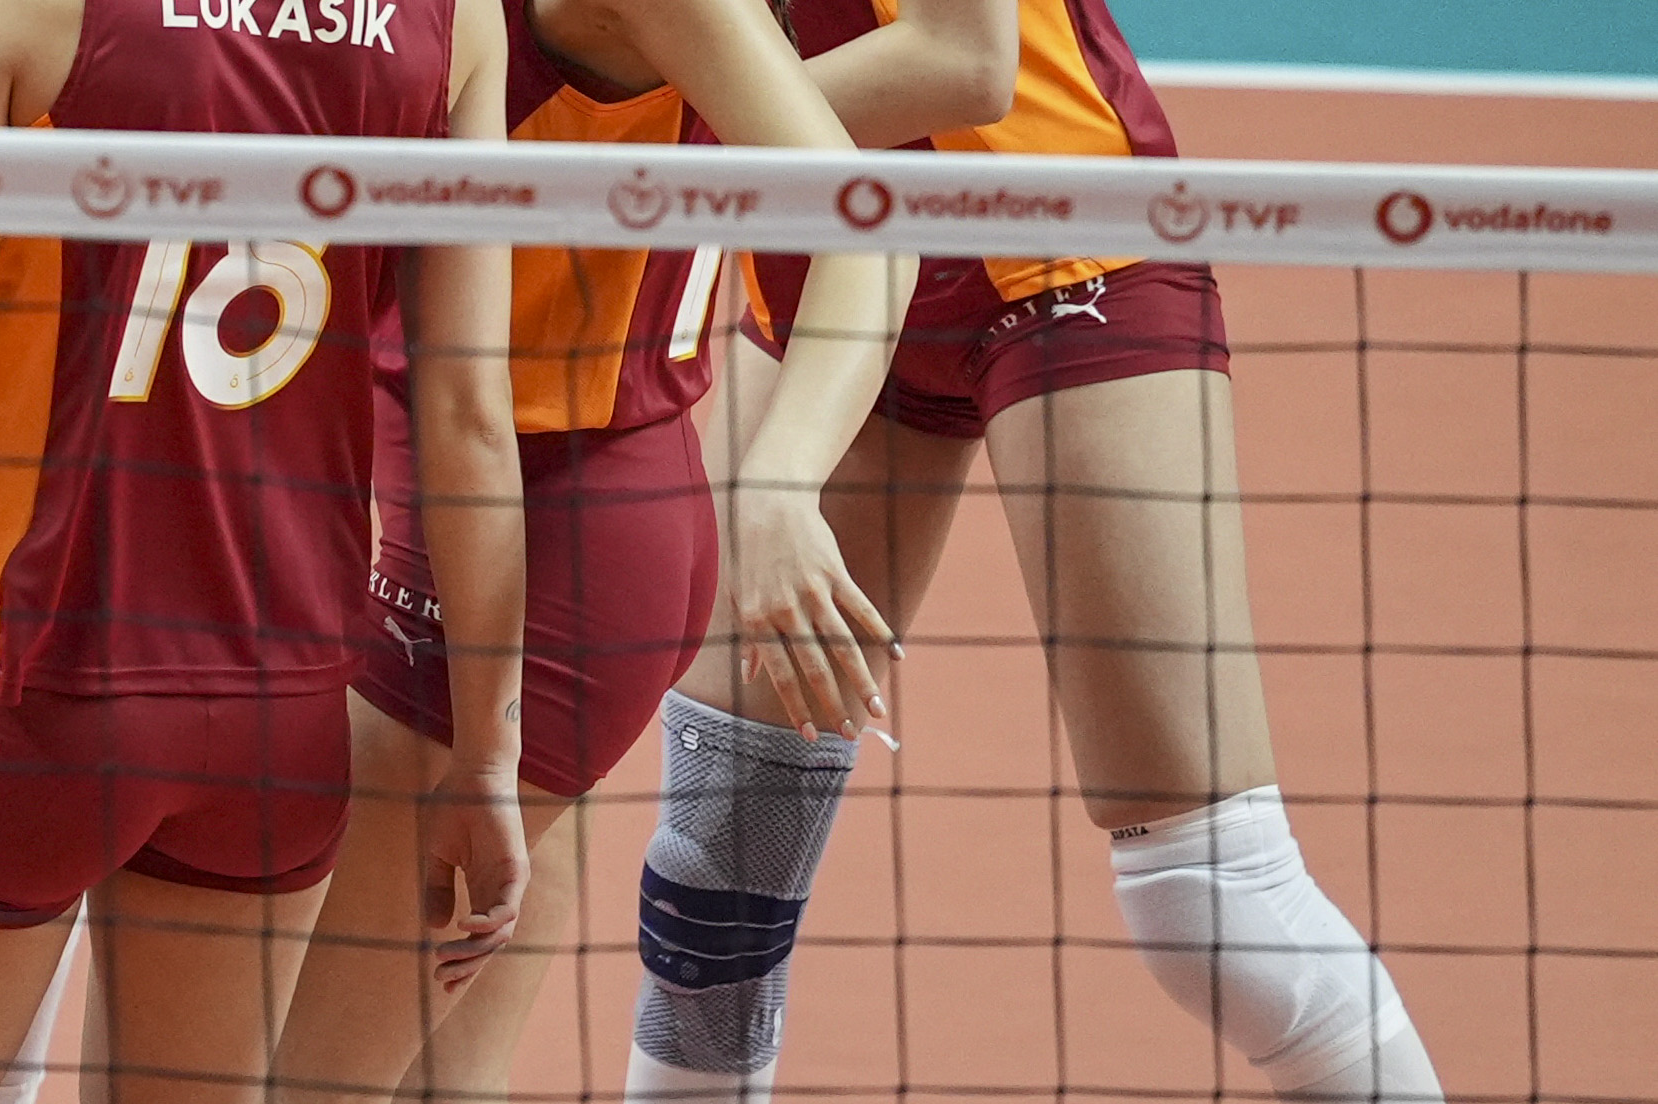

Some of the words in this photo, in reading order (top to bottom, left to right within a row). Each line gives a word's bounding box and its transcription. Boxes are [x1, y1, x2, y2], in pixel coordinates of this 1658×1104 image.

[141, 175, 228, 208] TVF
[366, 174, 536, 207] vodafone
[680, 186, 760, 218] TVF
[903, 189, 1074, 221] vodafone
[1218, 199, 1302, 234] TVF
[1444, 201, 1613, 234] vodafone
